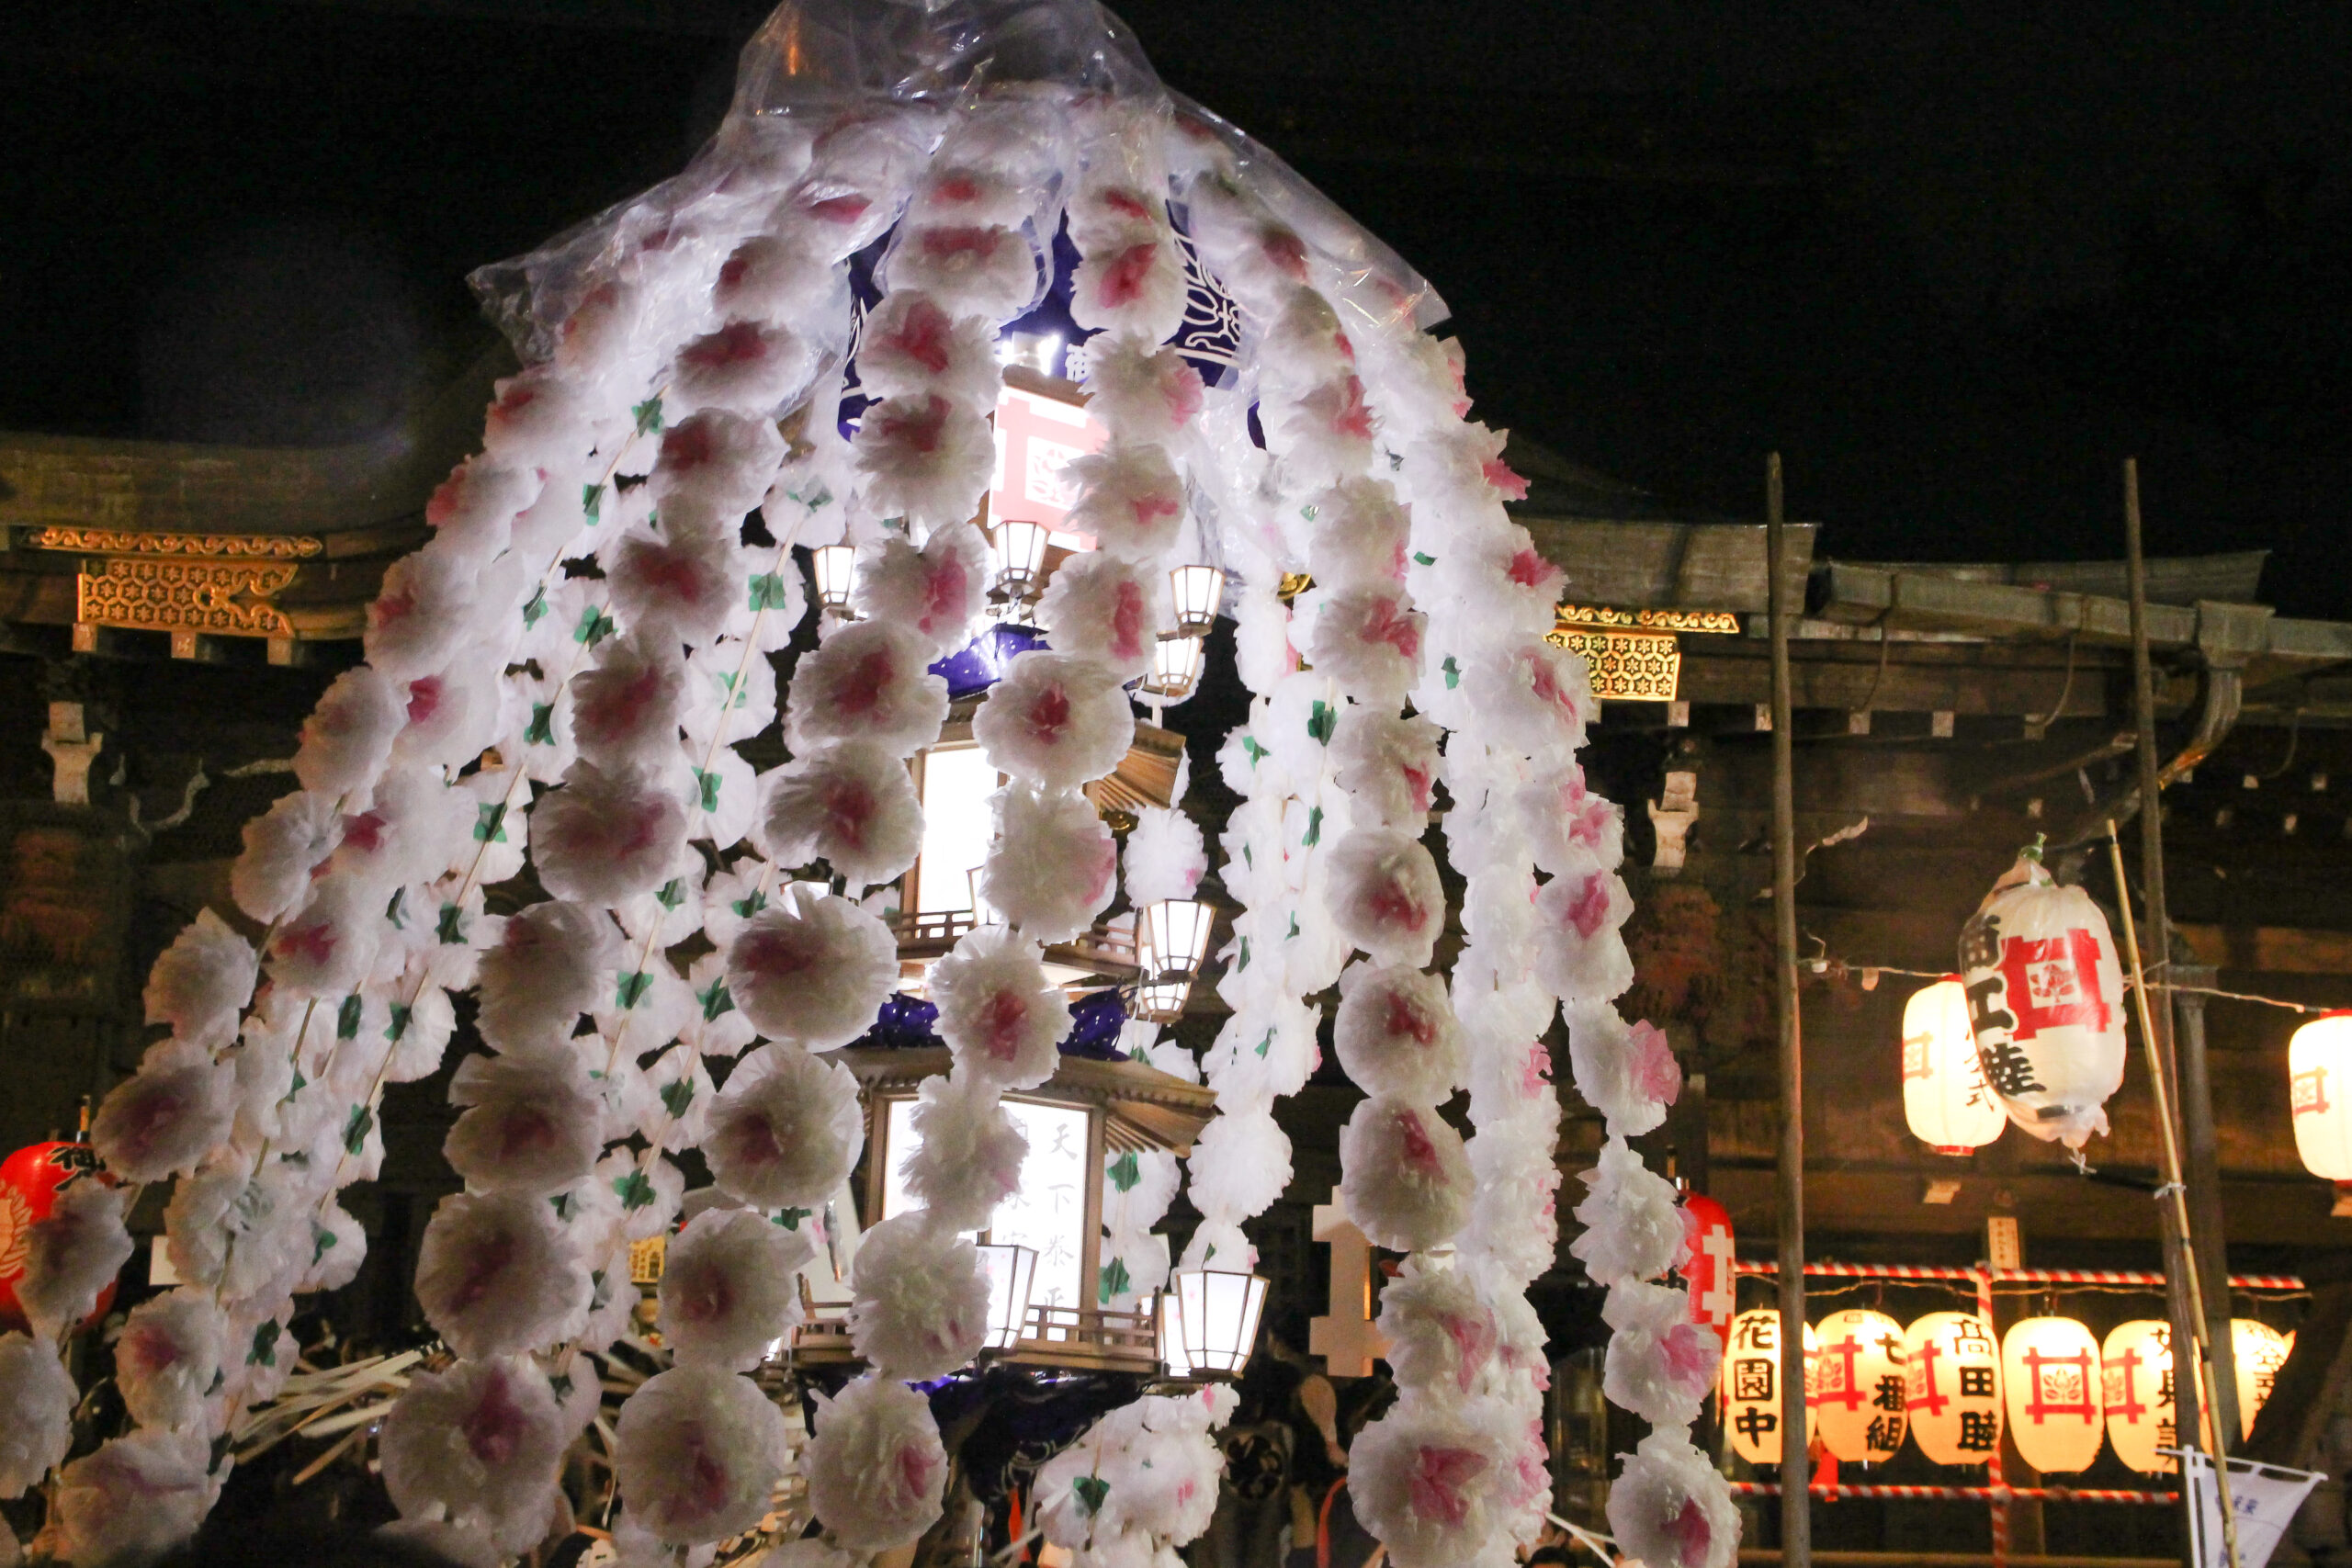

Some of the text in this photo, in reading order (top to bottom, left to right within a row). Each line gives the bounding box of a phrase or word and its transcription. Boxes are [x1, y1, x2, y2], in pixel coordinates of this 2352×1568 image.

[1043, 1122, 1078, 1323] 天下泰平
[1734, 1315, 1777, 1448] 花園中
[1866, 1332, 1906, 1451] 七番組
